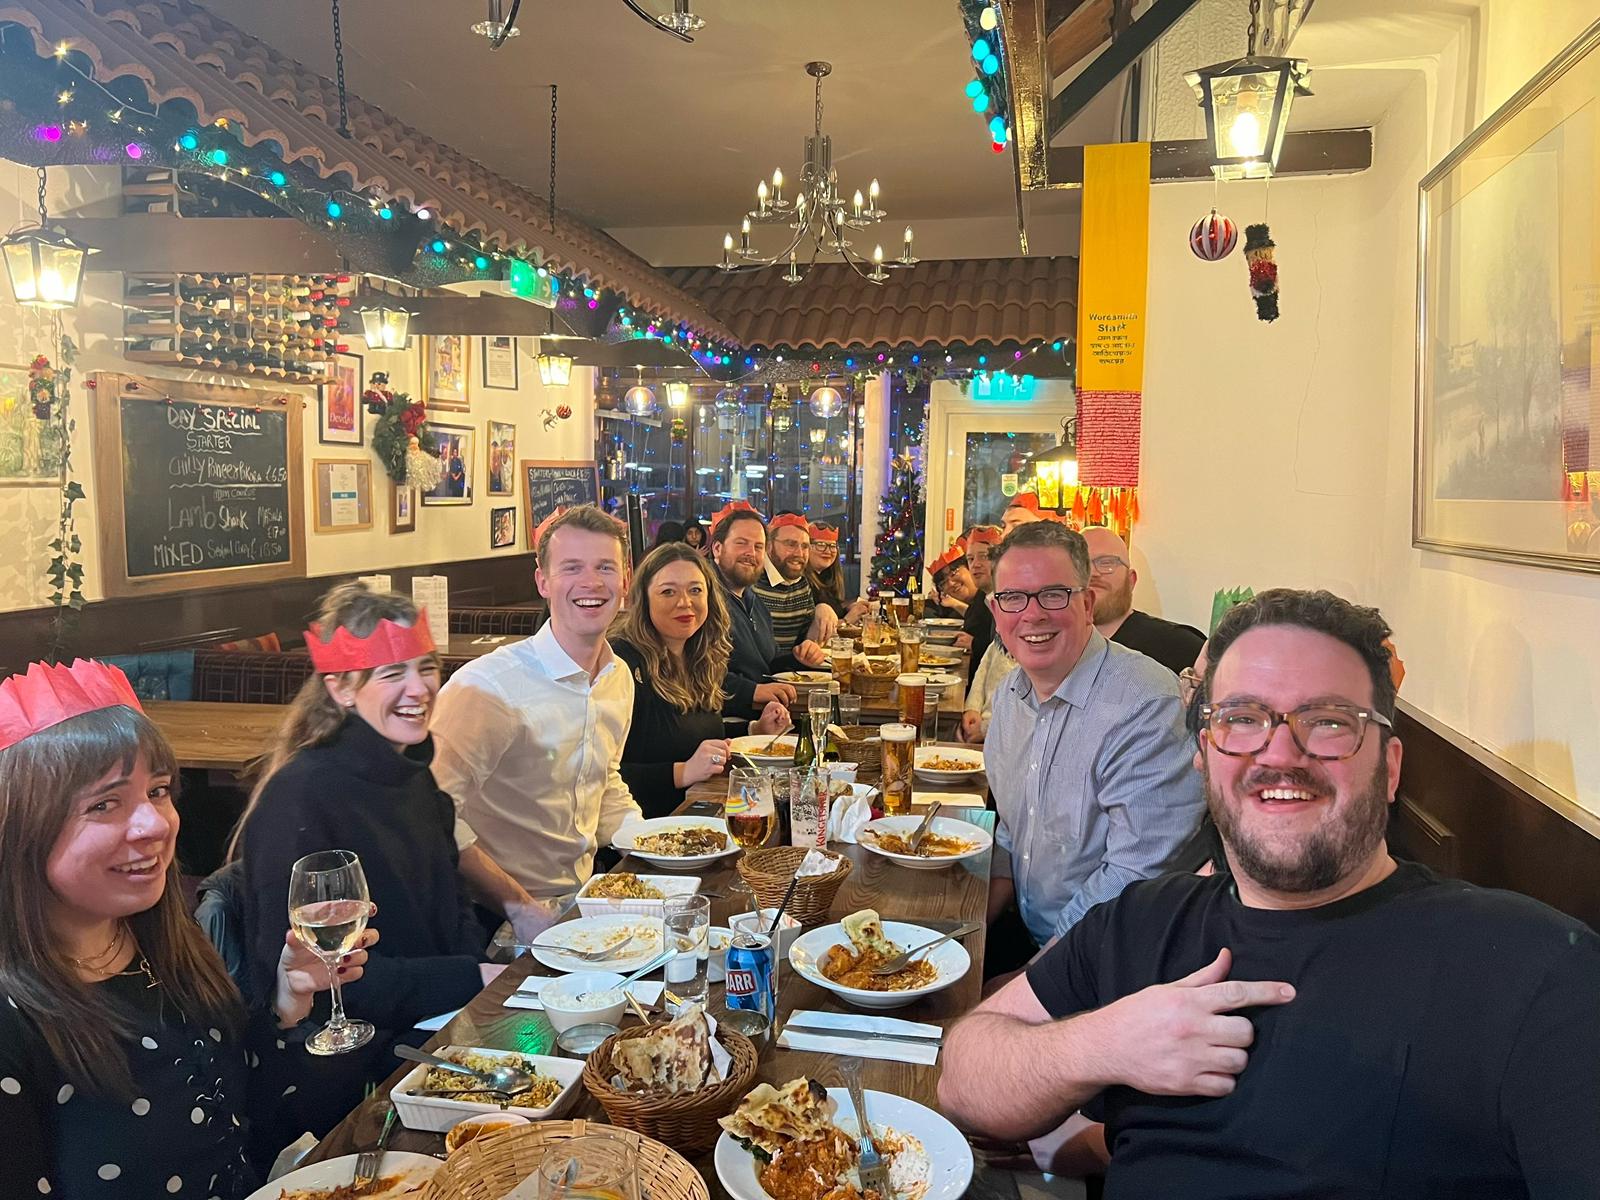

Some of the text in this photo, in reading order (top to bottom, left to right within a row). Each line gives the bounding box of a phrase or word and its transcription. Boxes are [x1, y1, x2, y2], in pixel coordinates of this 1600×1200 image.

[167, 406, 197, 430] DAY
[186, 431, 232, 449] STARTER
[815, 788, 828, 847] KINGFISHER
